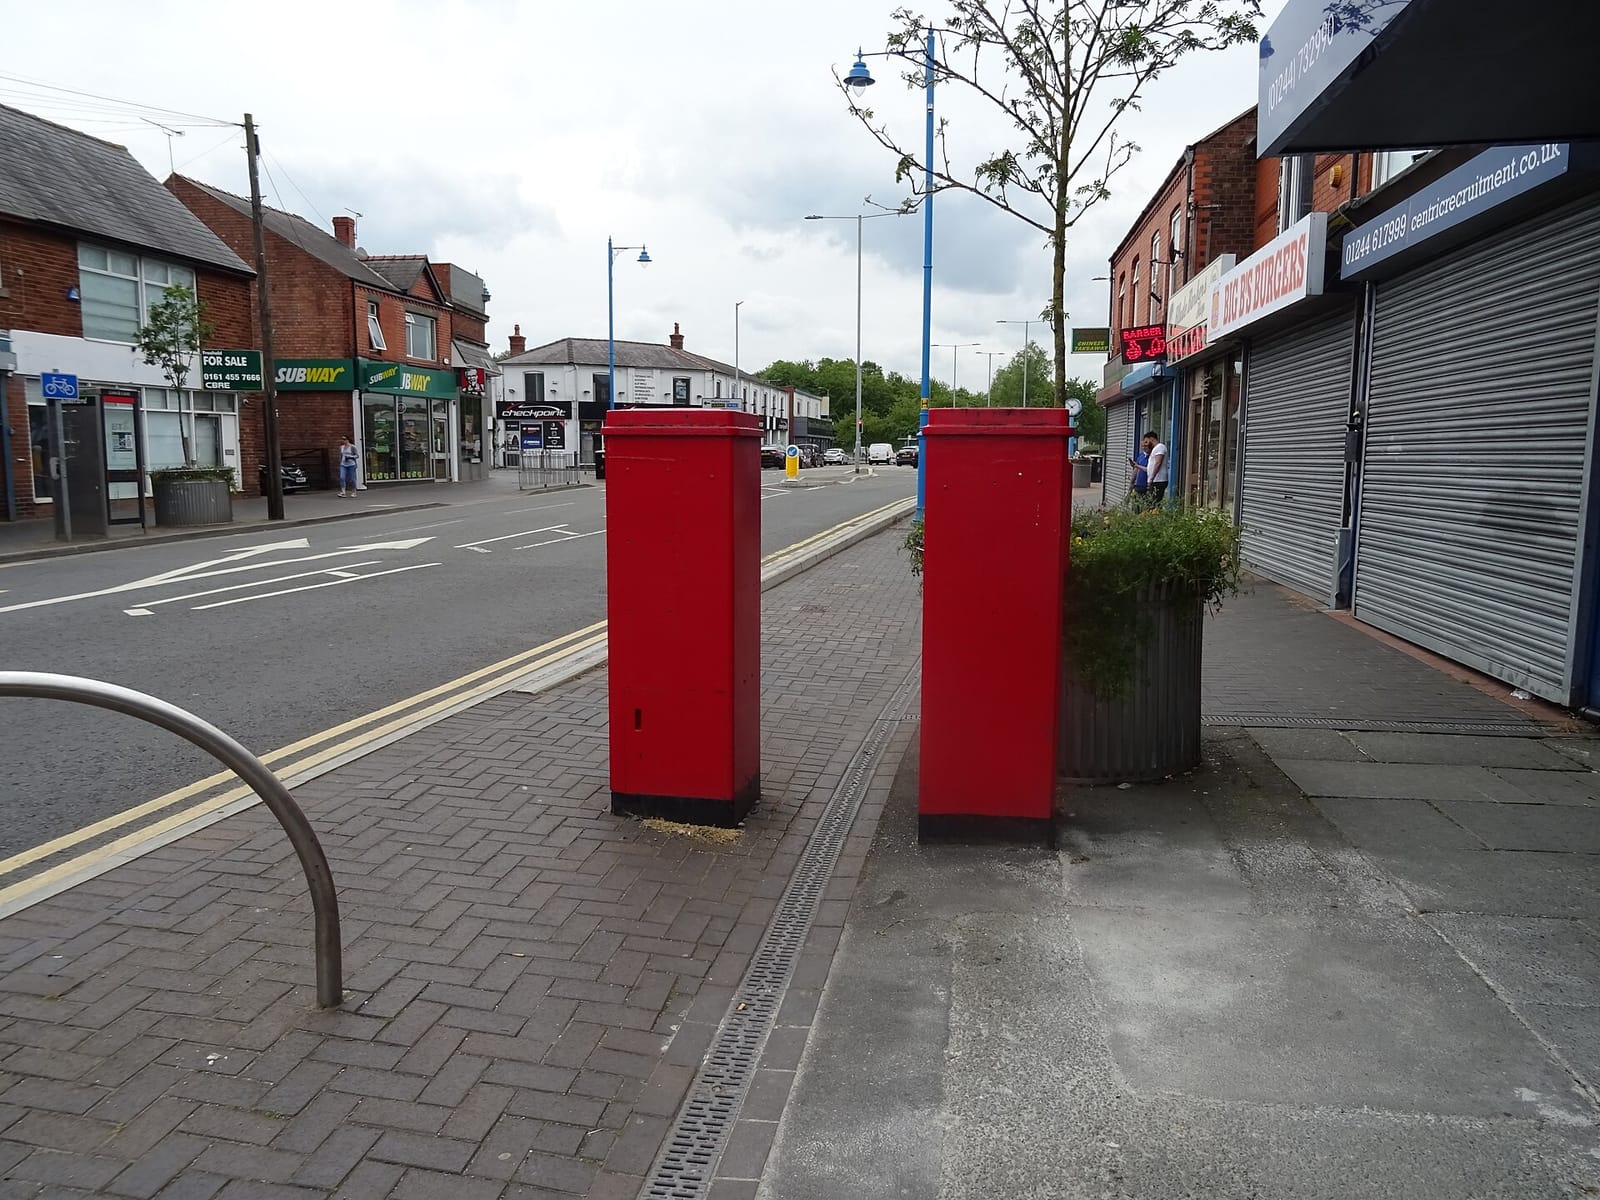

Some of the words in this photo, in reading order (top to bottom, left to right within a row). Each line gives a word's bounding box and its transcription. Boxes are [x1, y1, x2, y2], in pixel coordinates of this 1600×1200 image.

[1268, 56, 1296, 117] (01244)
[1298, 13, 1335, 80] 732990
[1345, 232, 1371, 265] 01244
[1372, 213, 1407, 252] 617999
[1410, 143, 1561, 231] centricrecruitment.co.uk
[1223, 277, 1238, 326] BIG
[1239, 268, 1254, 318] B'S
[1253, 232, 1307, 309] BURGERS
[1123, 327, 1162, 340] BARBER
[203, 356, 223, 366] FOR
[224, 356, 248, 367] SALE
[203, 373, 223, 381] 0161
[225, 373, 240, 381] 455
[275, 366, 346, 383] SUBWAY
[369, 366, 398, 385] SUBWAY
[205, 381, 231, 389] CBRE
[501, 409, 566, 418] checkpoint
